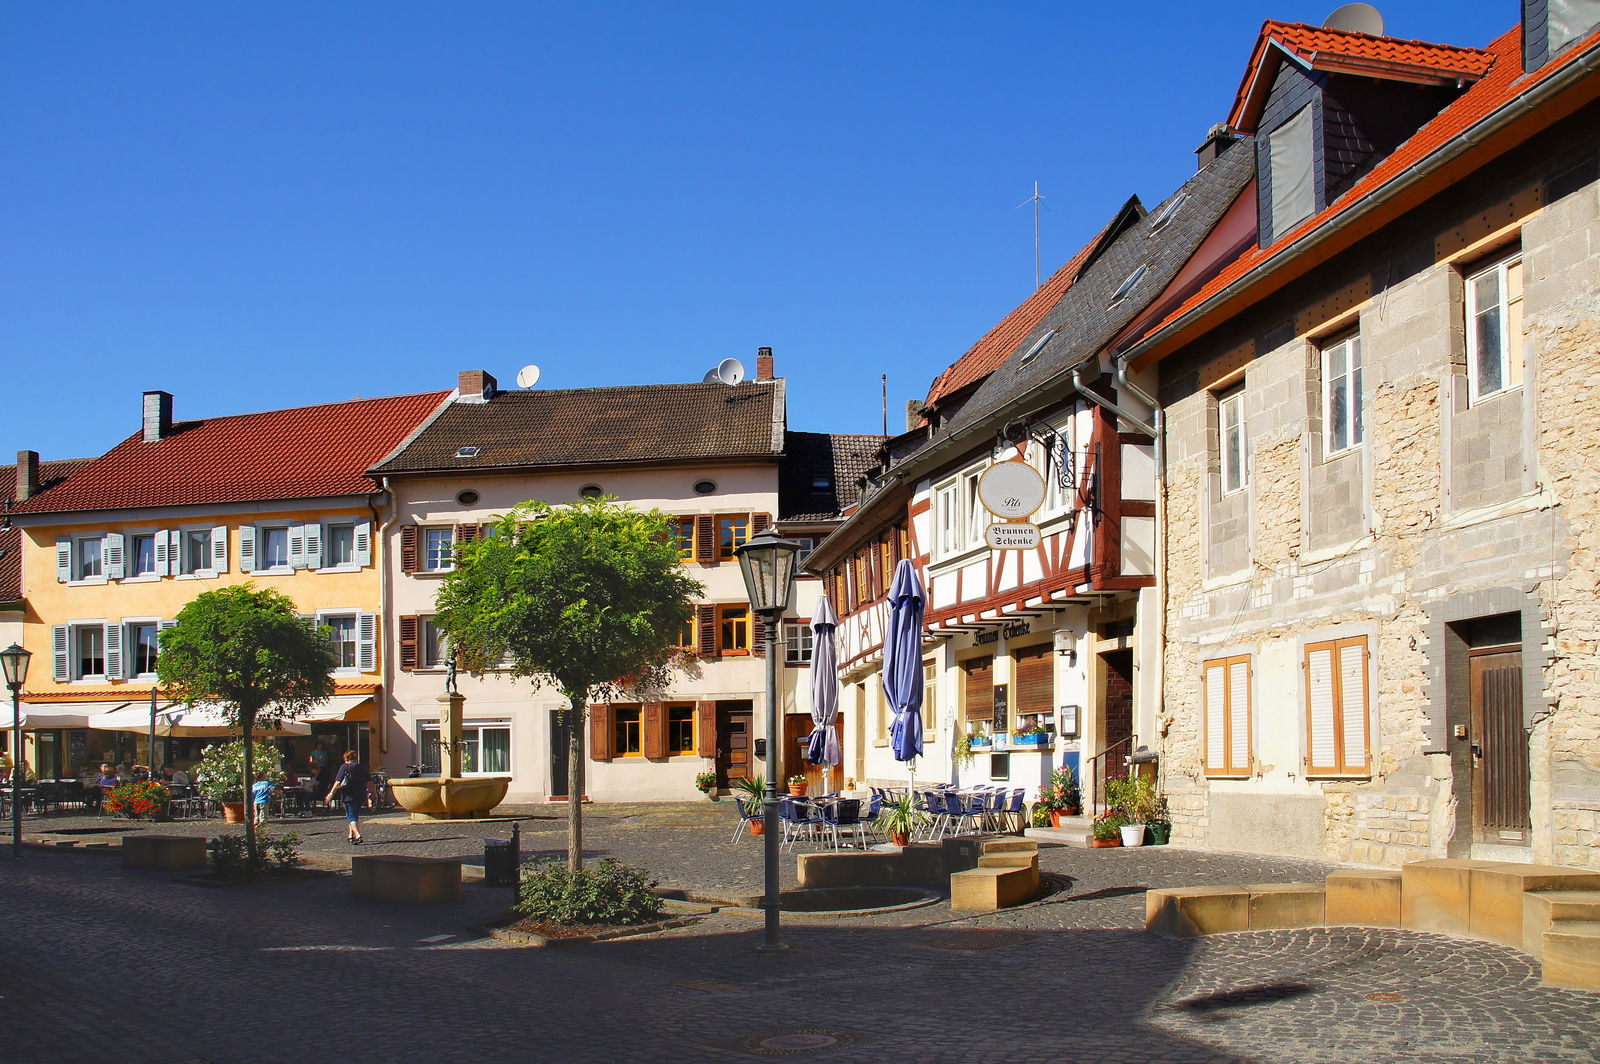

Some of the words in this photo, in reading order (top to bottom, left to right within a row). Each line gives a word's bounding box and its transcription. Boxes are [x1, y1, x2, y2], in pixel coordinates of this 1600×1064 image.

[1002, 497, 1021, 508] Pils
[992, 526, 1034, 535] Brunnen
[995, 537, 1033, 547] Schenke
